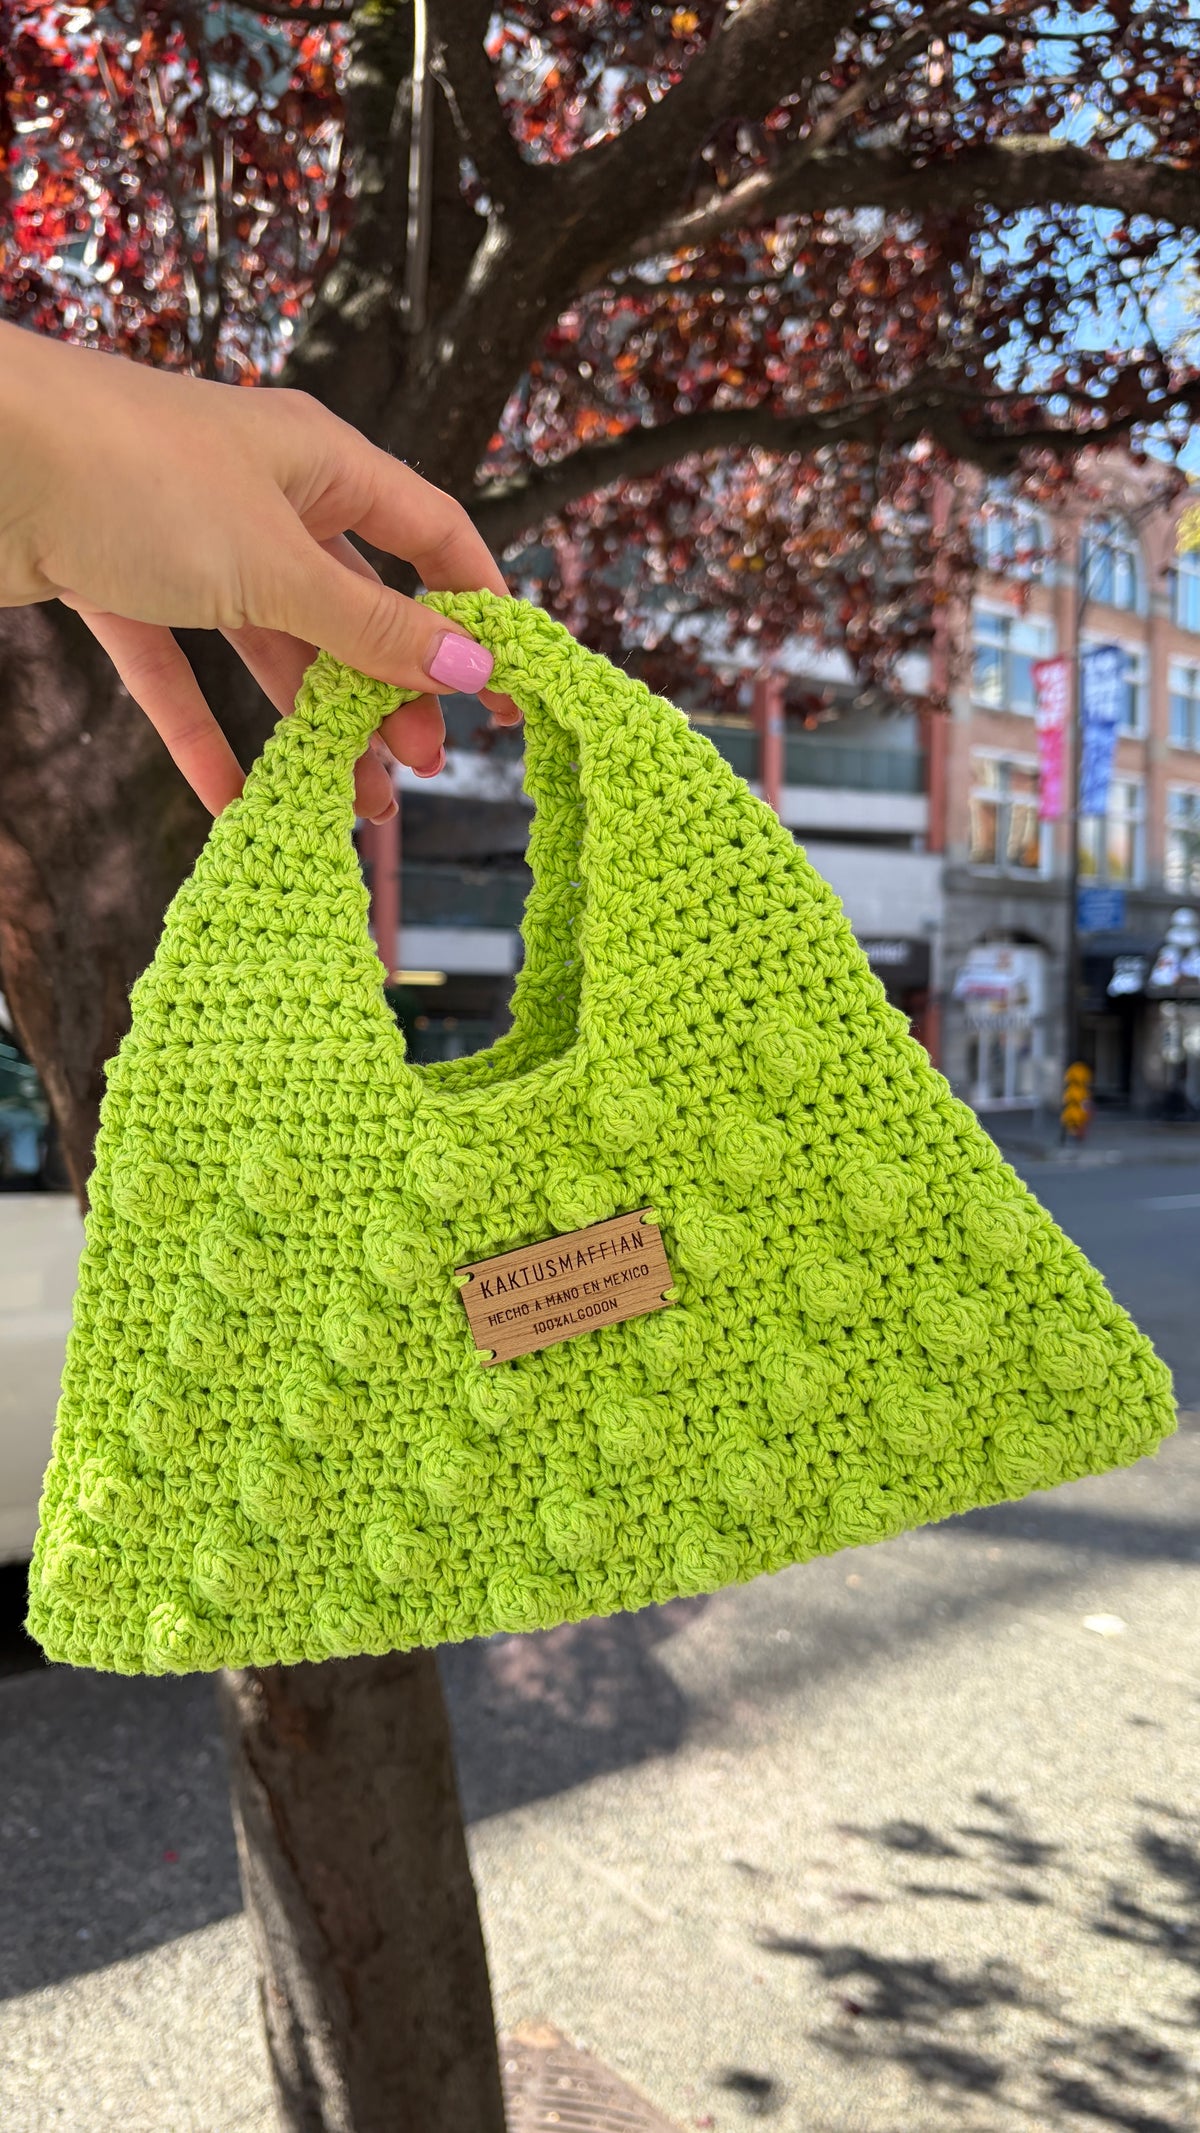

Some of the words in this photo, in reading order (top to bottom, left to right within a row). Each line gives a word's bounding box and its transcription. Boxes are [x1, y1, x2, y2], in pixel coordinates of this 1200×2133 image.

[480, 1231, 644, 1299] KAKTUSMAFFIAN
[488, 1302, 530, 1327] HECHO
[535, 1300, 542, 1312] A
[546, 1287, 580, 1308] MANO
[584, 1279, 599, 1295] EN
[604, 1264, 650, 1290] MEXICO
